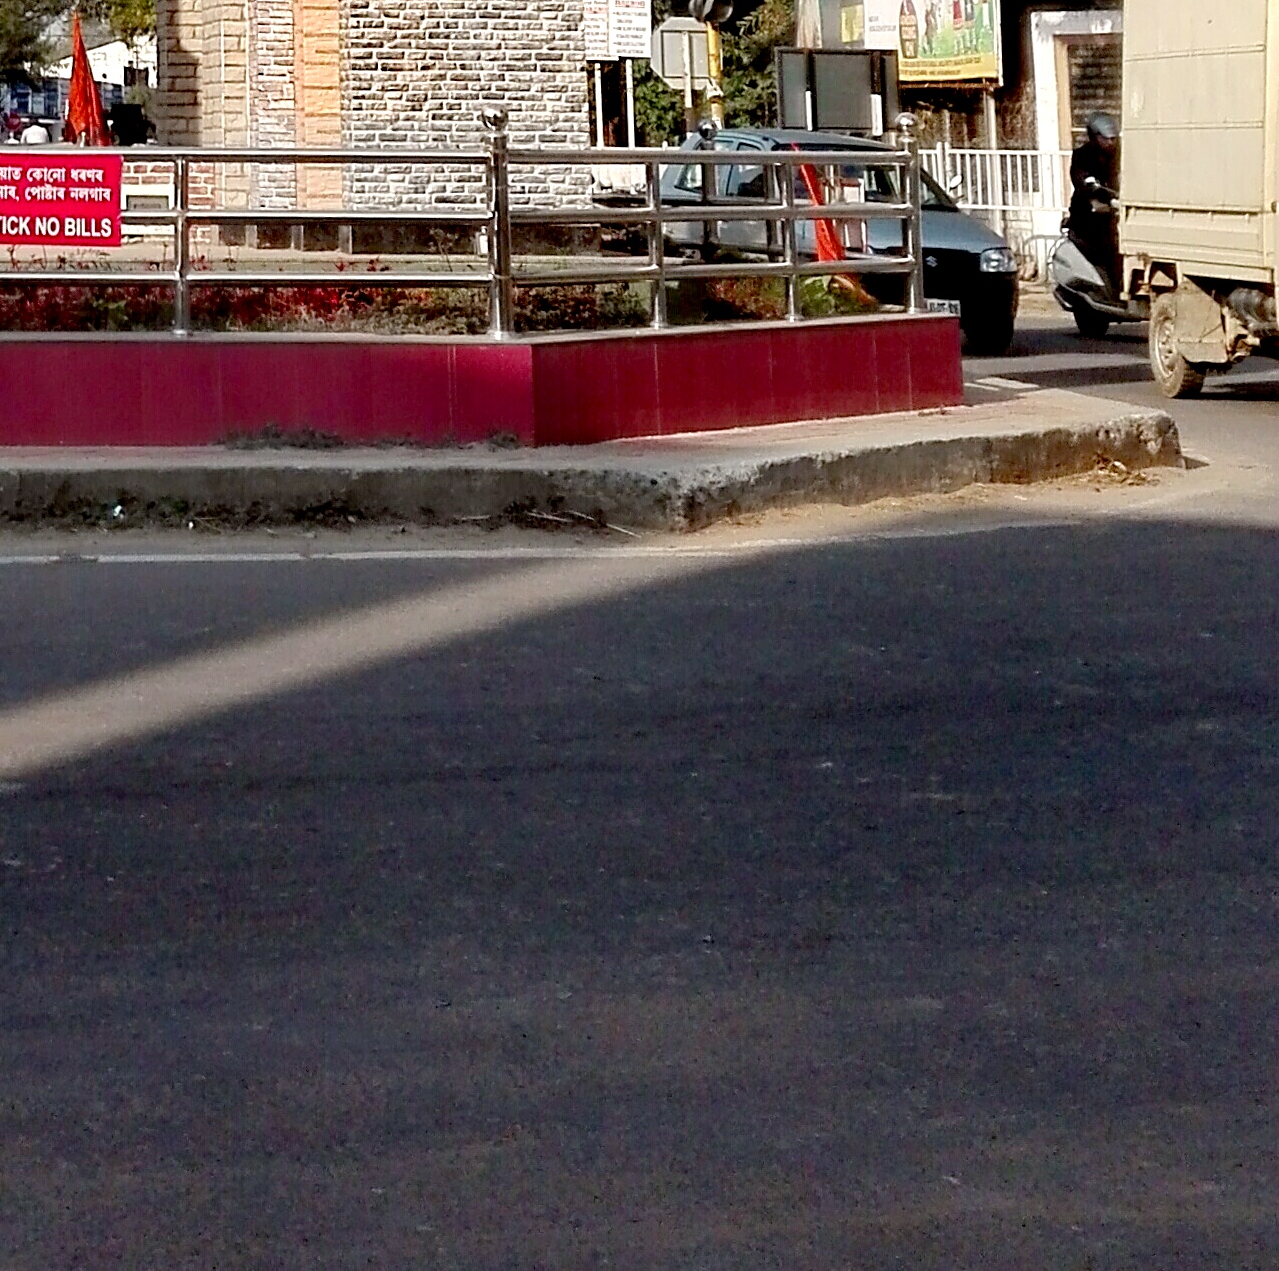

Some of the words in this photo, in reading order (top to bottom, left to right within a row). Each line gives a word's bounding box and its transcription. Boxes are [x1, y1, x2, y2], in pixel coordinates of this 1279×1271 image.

[26, 167, 66, 183] কোনো
[35, 216, 60, 236] NO
[64, 217, 112, 238] BILLS
